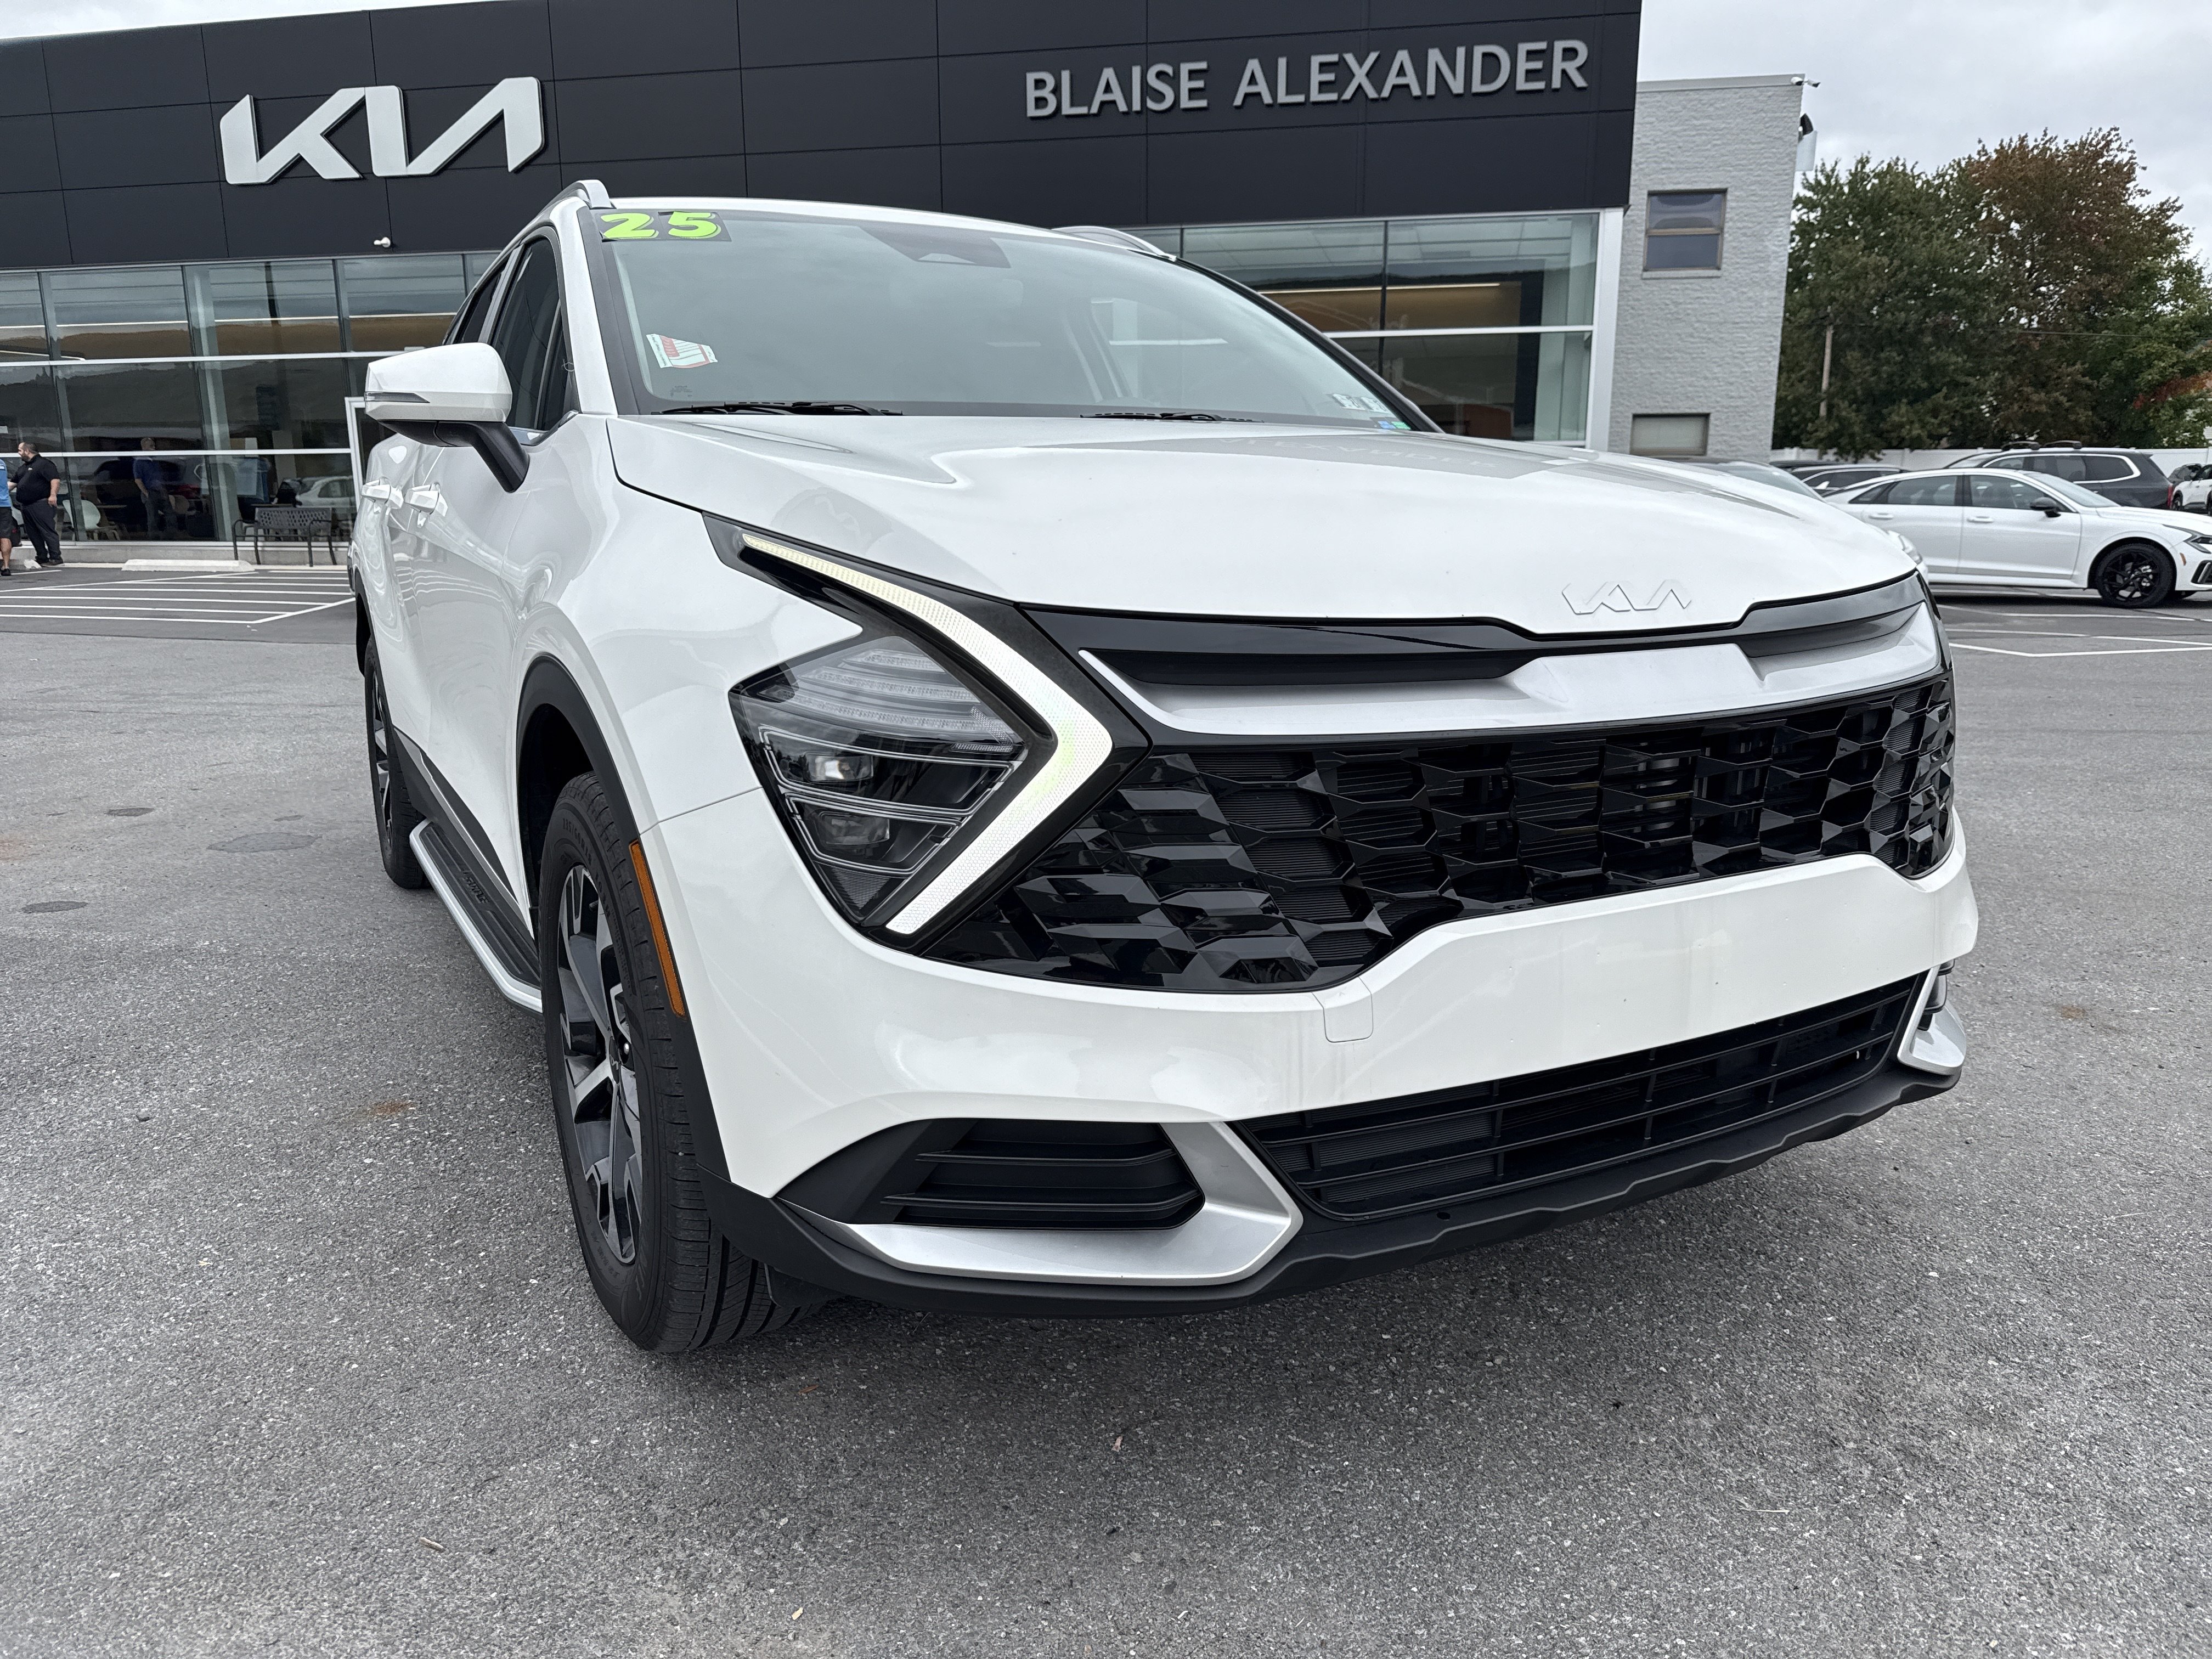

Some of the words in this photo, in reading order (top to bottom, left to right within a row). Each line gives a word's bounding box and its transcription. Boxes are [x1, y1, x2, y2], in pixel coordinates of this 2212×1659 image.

[1025, 61, 1208, 117] BLAISE
[1232, 38, 1589, 106] ALEXANDER
[219, 76, 543, 185] KIA
[601, 211, 721, 239] 25
